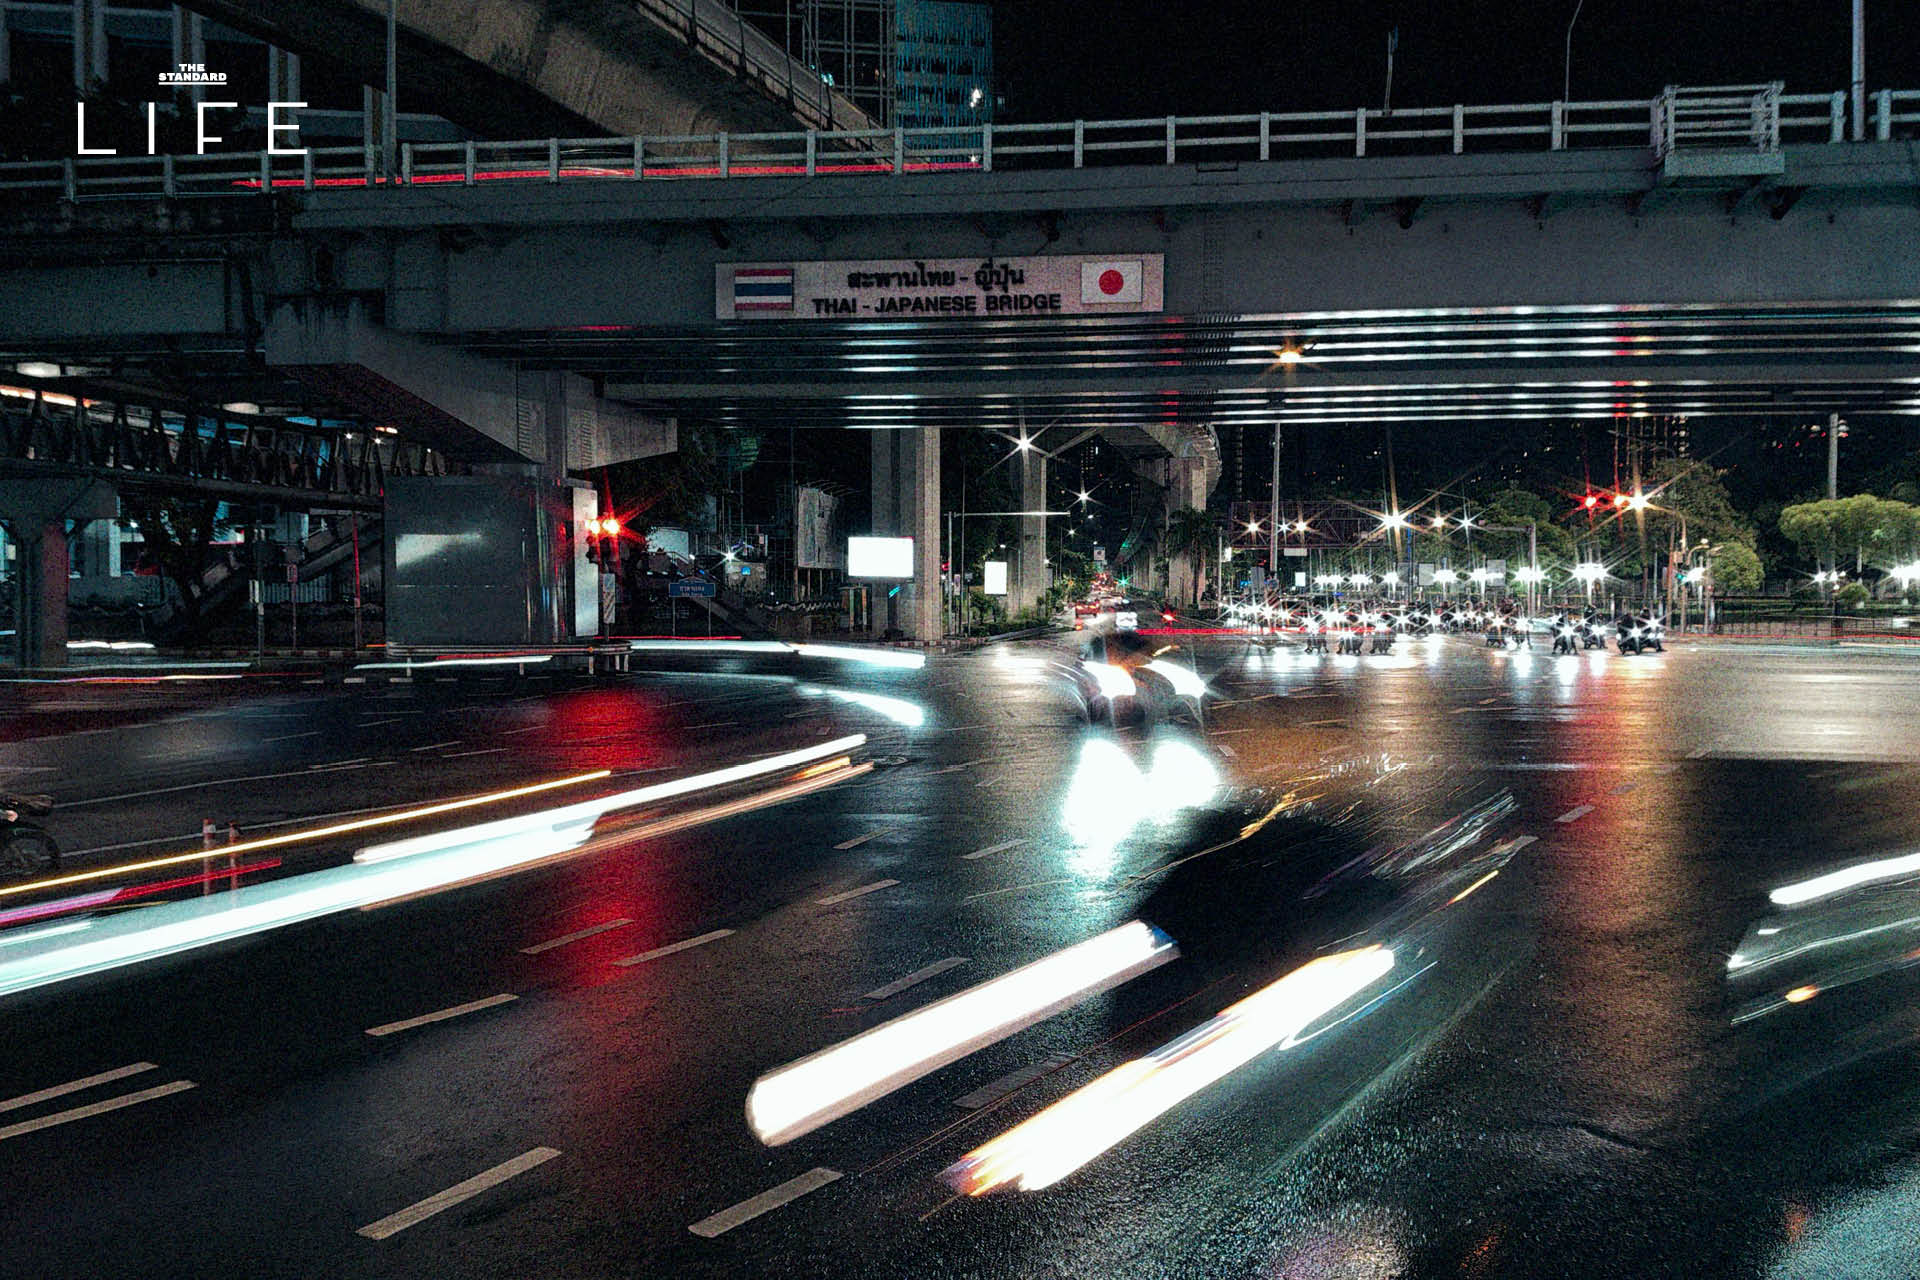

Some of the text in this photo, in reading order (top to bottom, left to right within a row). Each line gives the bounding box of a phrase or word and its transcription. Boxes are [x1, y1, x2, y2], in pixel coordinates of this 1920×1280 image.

[812, 297, 857, 314] THAI
[874, 295, 977, 313] JAPANESE
[985, 293, 1061, 311] BRIDGE
